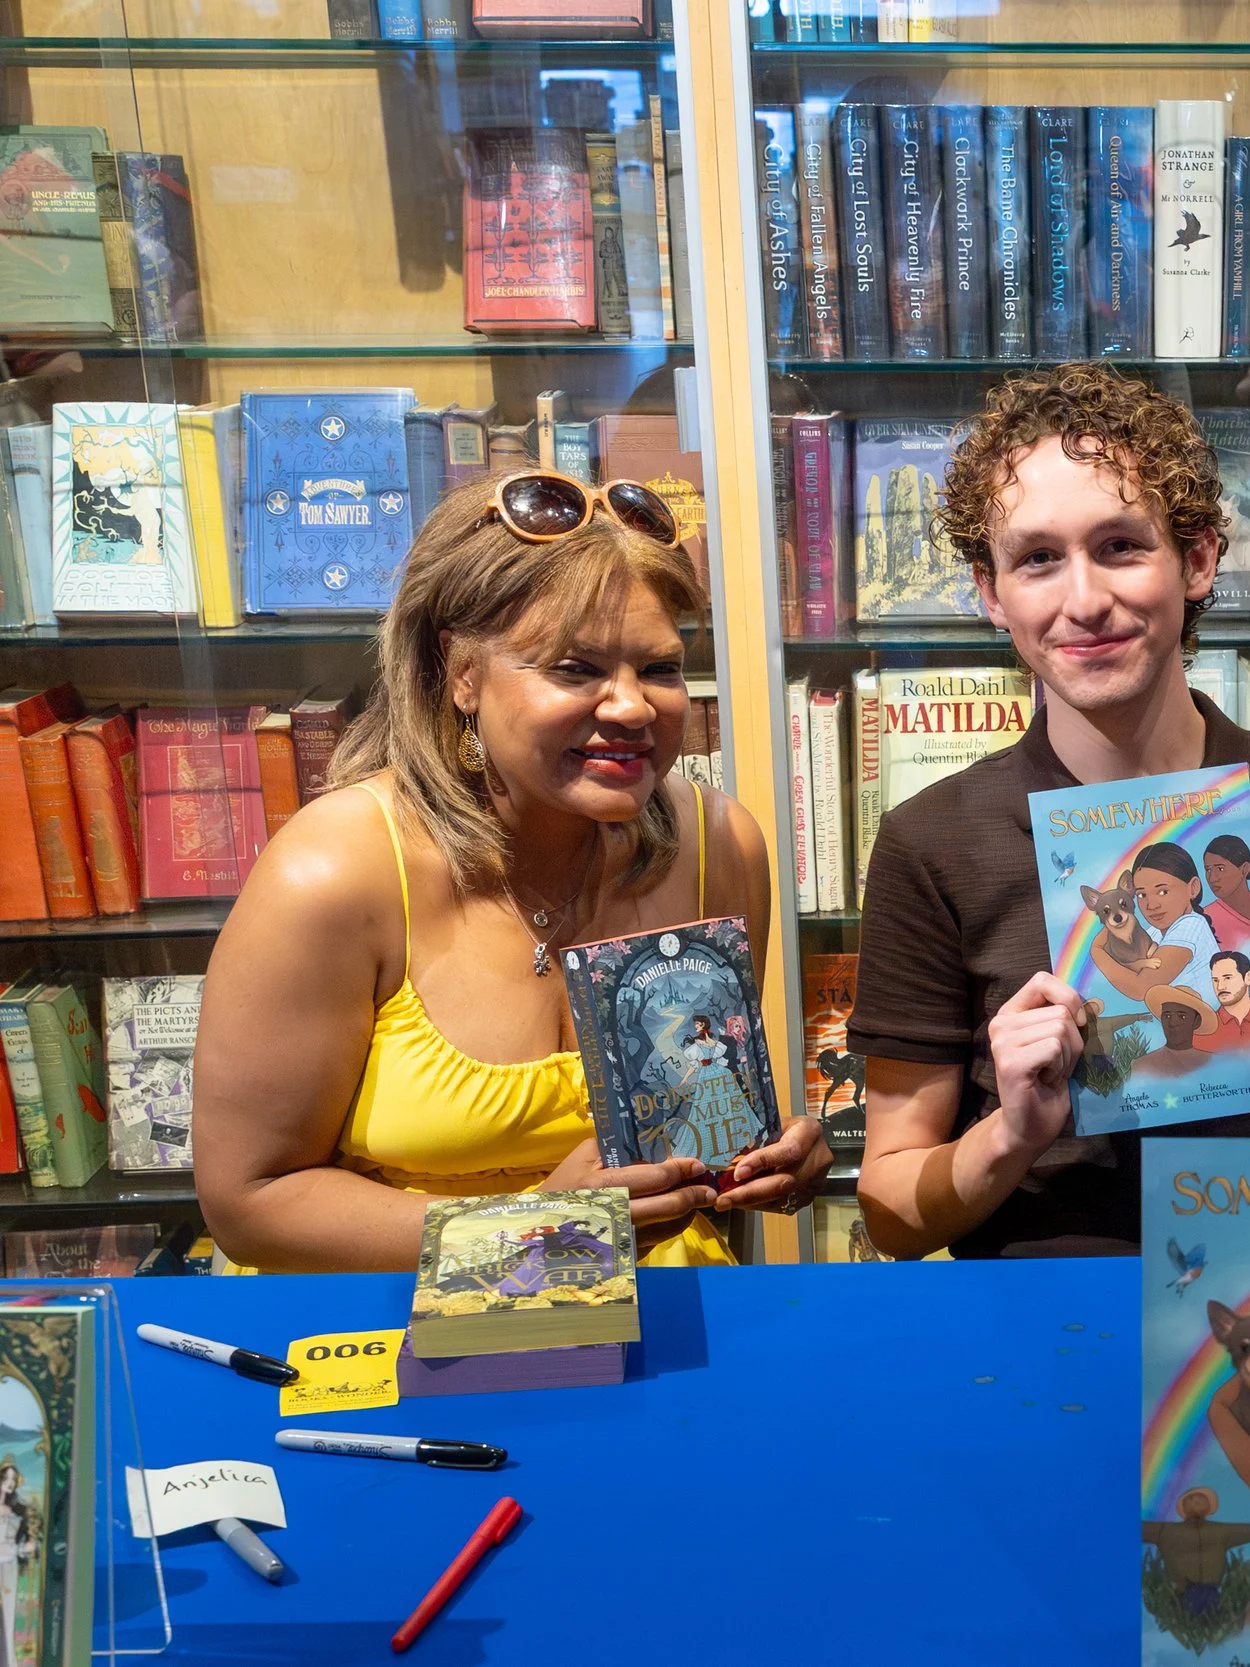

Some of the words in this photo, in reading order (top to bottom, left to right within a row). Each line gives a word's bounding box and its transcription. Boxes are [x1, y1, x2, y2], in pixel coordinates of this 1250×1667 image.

[1042, 118, 1073, 127] CLARE
[764, 143, 784, 193] City
[804, 143, 822, 181] City
[848, 139, 866, 177] City
[901, 141, 919, 178] City
[1000, 144, 1015, 173] The
[1049, 136, 1068, 190] Lord
[1108, 135, 1121, 178] Queen
[1162, 150, 1215, 160] JONATHAN
[1162, 162, 1214, 172] STRANGE
[807, 184, 823, 200] of
[852, 181, 868, 194] of
[904, 182, 920, 195] of
[955, 138, 971, 232] Clockwork
[1001, 178, 1016, 222] Bane
[1111, 181, 1122, 199] of
[1174, 195, 1214, 203] NORRELL
[766, 198, 787, 222] of
[853, 200, 869, 239] Lost
[1053, 193, 1069, 218] of
[1111, 200, 1122, 221] Air
[810, 206, 826, 256] Fallen
[905, 202, 921, 283] Heavenly
[1111, 223, 1122, 248] and
[770, 222, 791, 291] Ashes
[856, 244, 873, 292] Souls
[958, 237, 972, 291] Prince
[1051, 219, 1069, 311] Shadows
[1001, 227, 1019, 320] Chronicles
[1111, 251, 1123, 311] Darkness
[811, 261, 831, 319] Angels
[911, 288, 925, 320] Fire
[559, 452, 587, 461] TARS
[562, 443, 582, 452] BOY
[901, 441, 921, 450] Susan
[922, 441, 944, 451] Cooper
[568, 461, 579, 469] OF
[299, 502, 325, 526] TOM
[325, 502, 371, 526] SAWYER.
[901, 678, 953, 697] Roald
[960, 678, 1007, 696] Dahl
[823, 711, 833, 734] The
[883, 701, 1028, 734] MATILDA
[861, 696, 879, 783] MATILDA
[924, 739, 972, 749] Illustrated
[974, 739, 987, 751] by
[823, 735, 837, 791] Wonderful
[823, 794, 839, 824] Story
[861, 790, 871, 825] Quentin
[1049, 788, 1221, 838] SOMEWHERE
[828, 825, 839, 837] of
[862, 827, 871, 850] Blake
[826, 840, 840, 874] Henry
[826, 875, 840, 908] Sugar
[635, 959, 681, 988] DANIELLE
[682, 958, 713, 975] PAIGE
[136, 1006, 152, 1015] THE
[154, 1006, 180, 1015] PICTS
[183, 1005, 200, 1015] AN
[136, 1017, 152, 1026] THE
[154, 1016, 200, 1026] MARTYRS
[633, 1069, 756, 1120] DOROTHY
[1200, 1082, 1229, 1093] Rebecca
[694, 1090, 759, 1122] MUST
[1119, 1100, 1159, 1113] THOMAS
[638, 1116, 750, 1170] DIE
[832, 1129, 867, 1138] WALTE
[306, 1342, 387, 1361] 006
[162, 1467, 269, 1497] Anjelica
